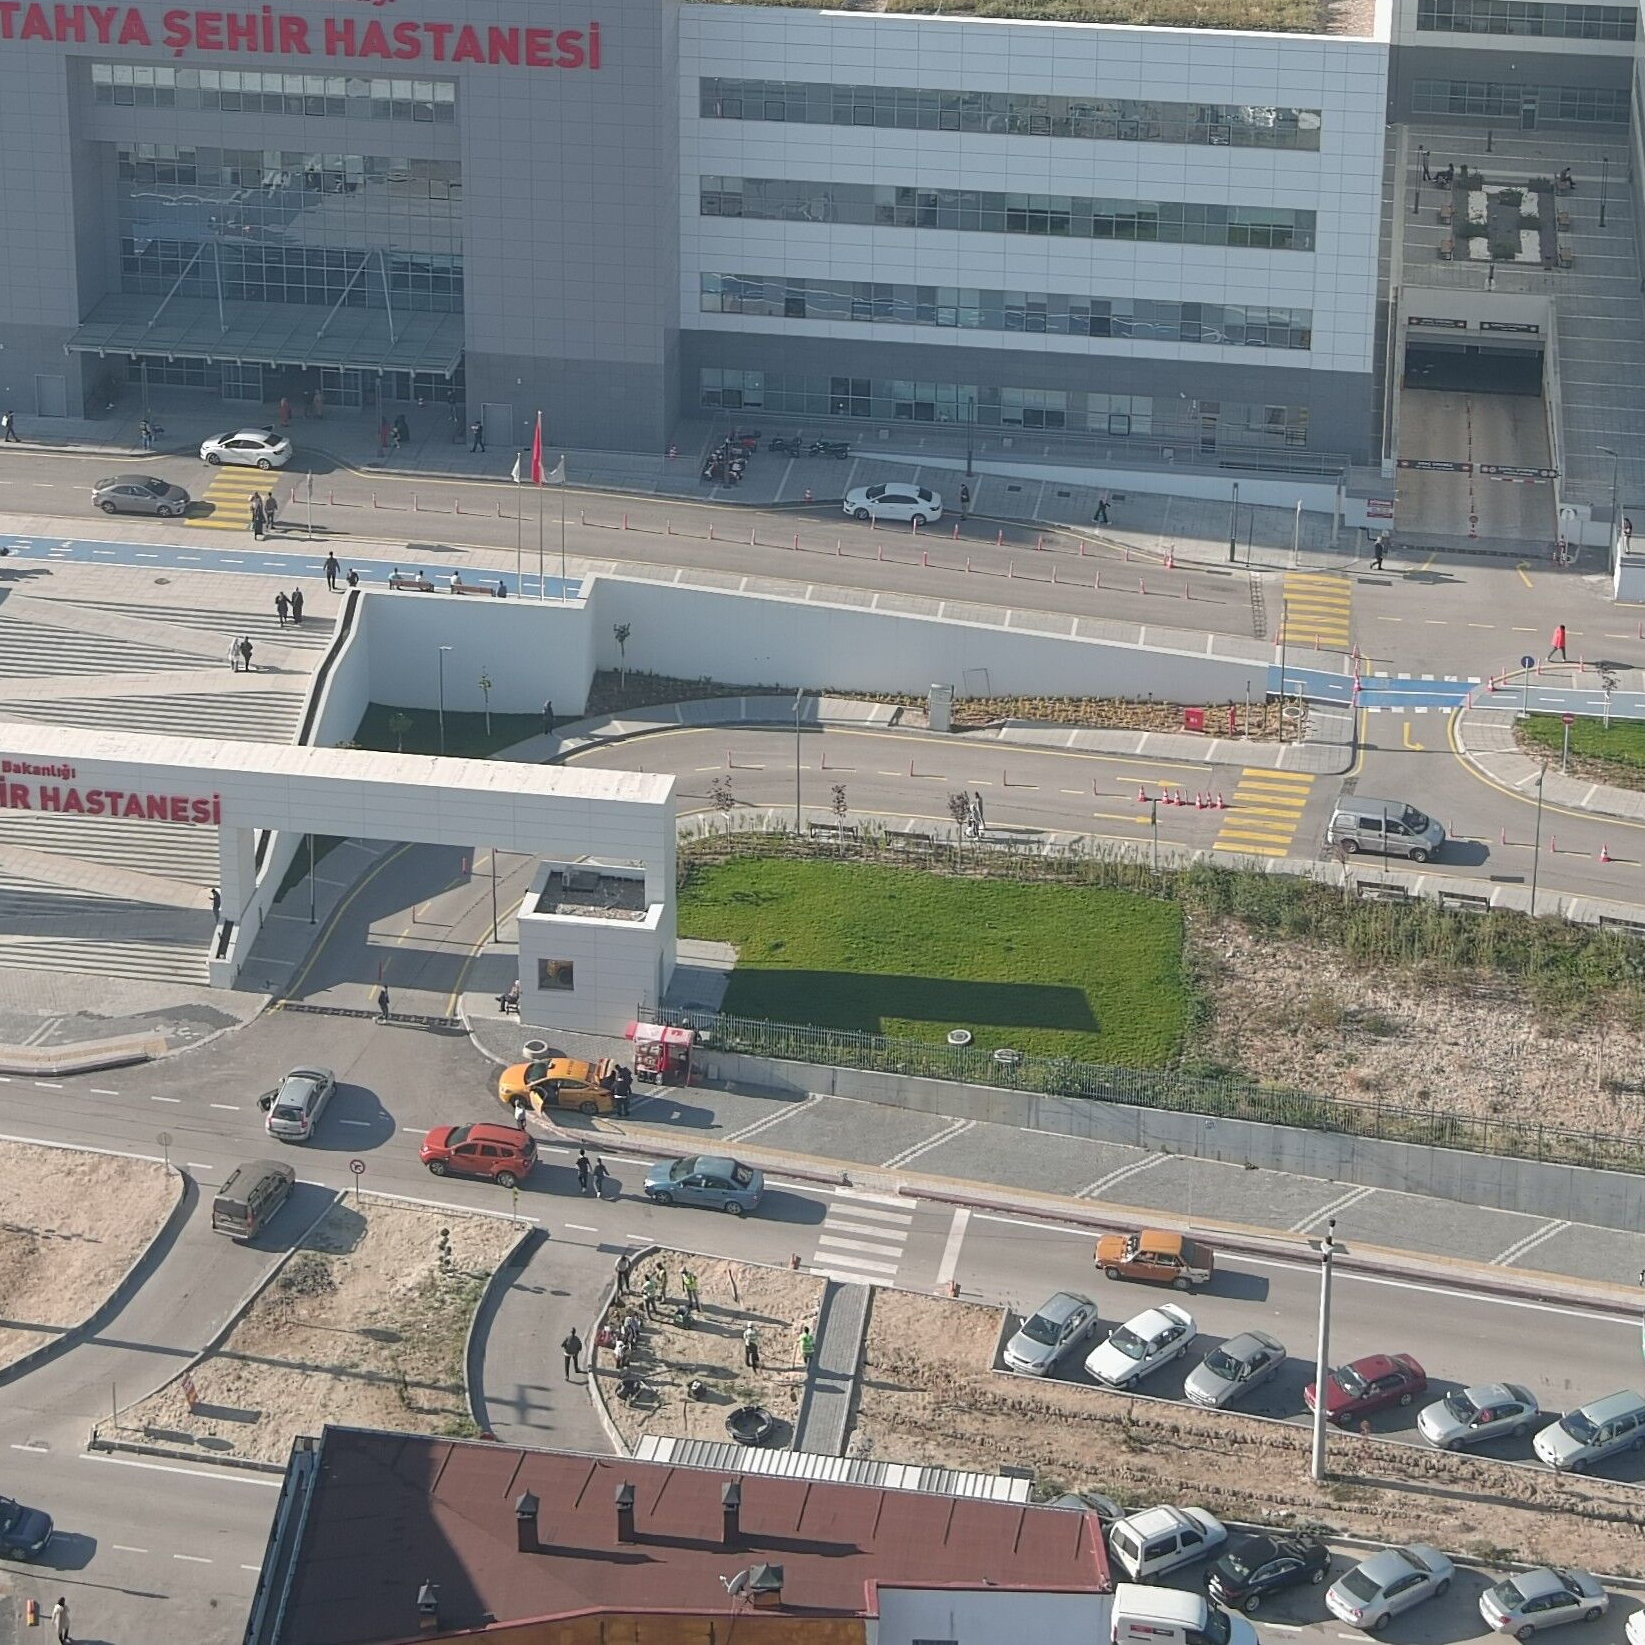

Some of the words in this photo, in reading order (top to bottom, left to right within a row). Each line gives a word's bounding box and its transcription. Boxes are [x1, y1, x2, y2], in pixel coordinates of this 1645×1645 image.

[163, 5, 309, 58] ŞEHİR
[324, 18, 601, 70] HASTANESİ
[1, 760, 77, 781] Bakanlığı
[39, 787, 223, 825] HASTANESİ
